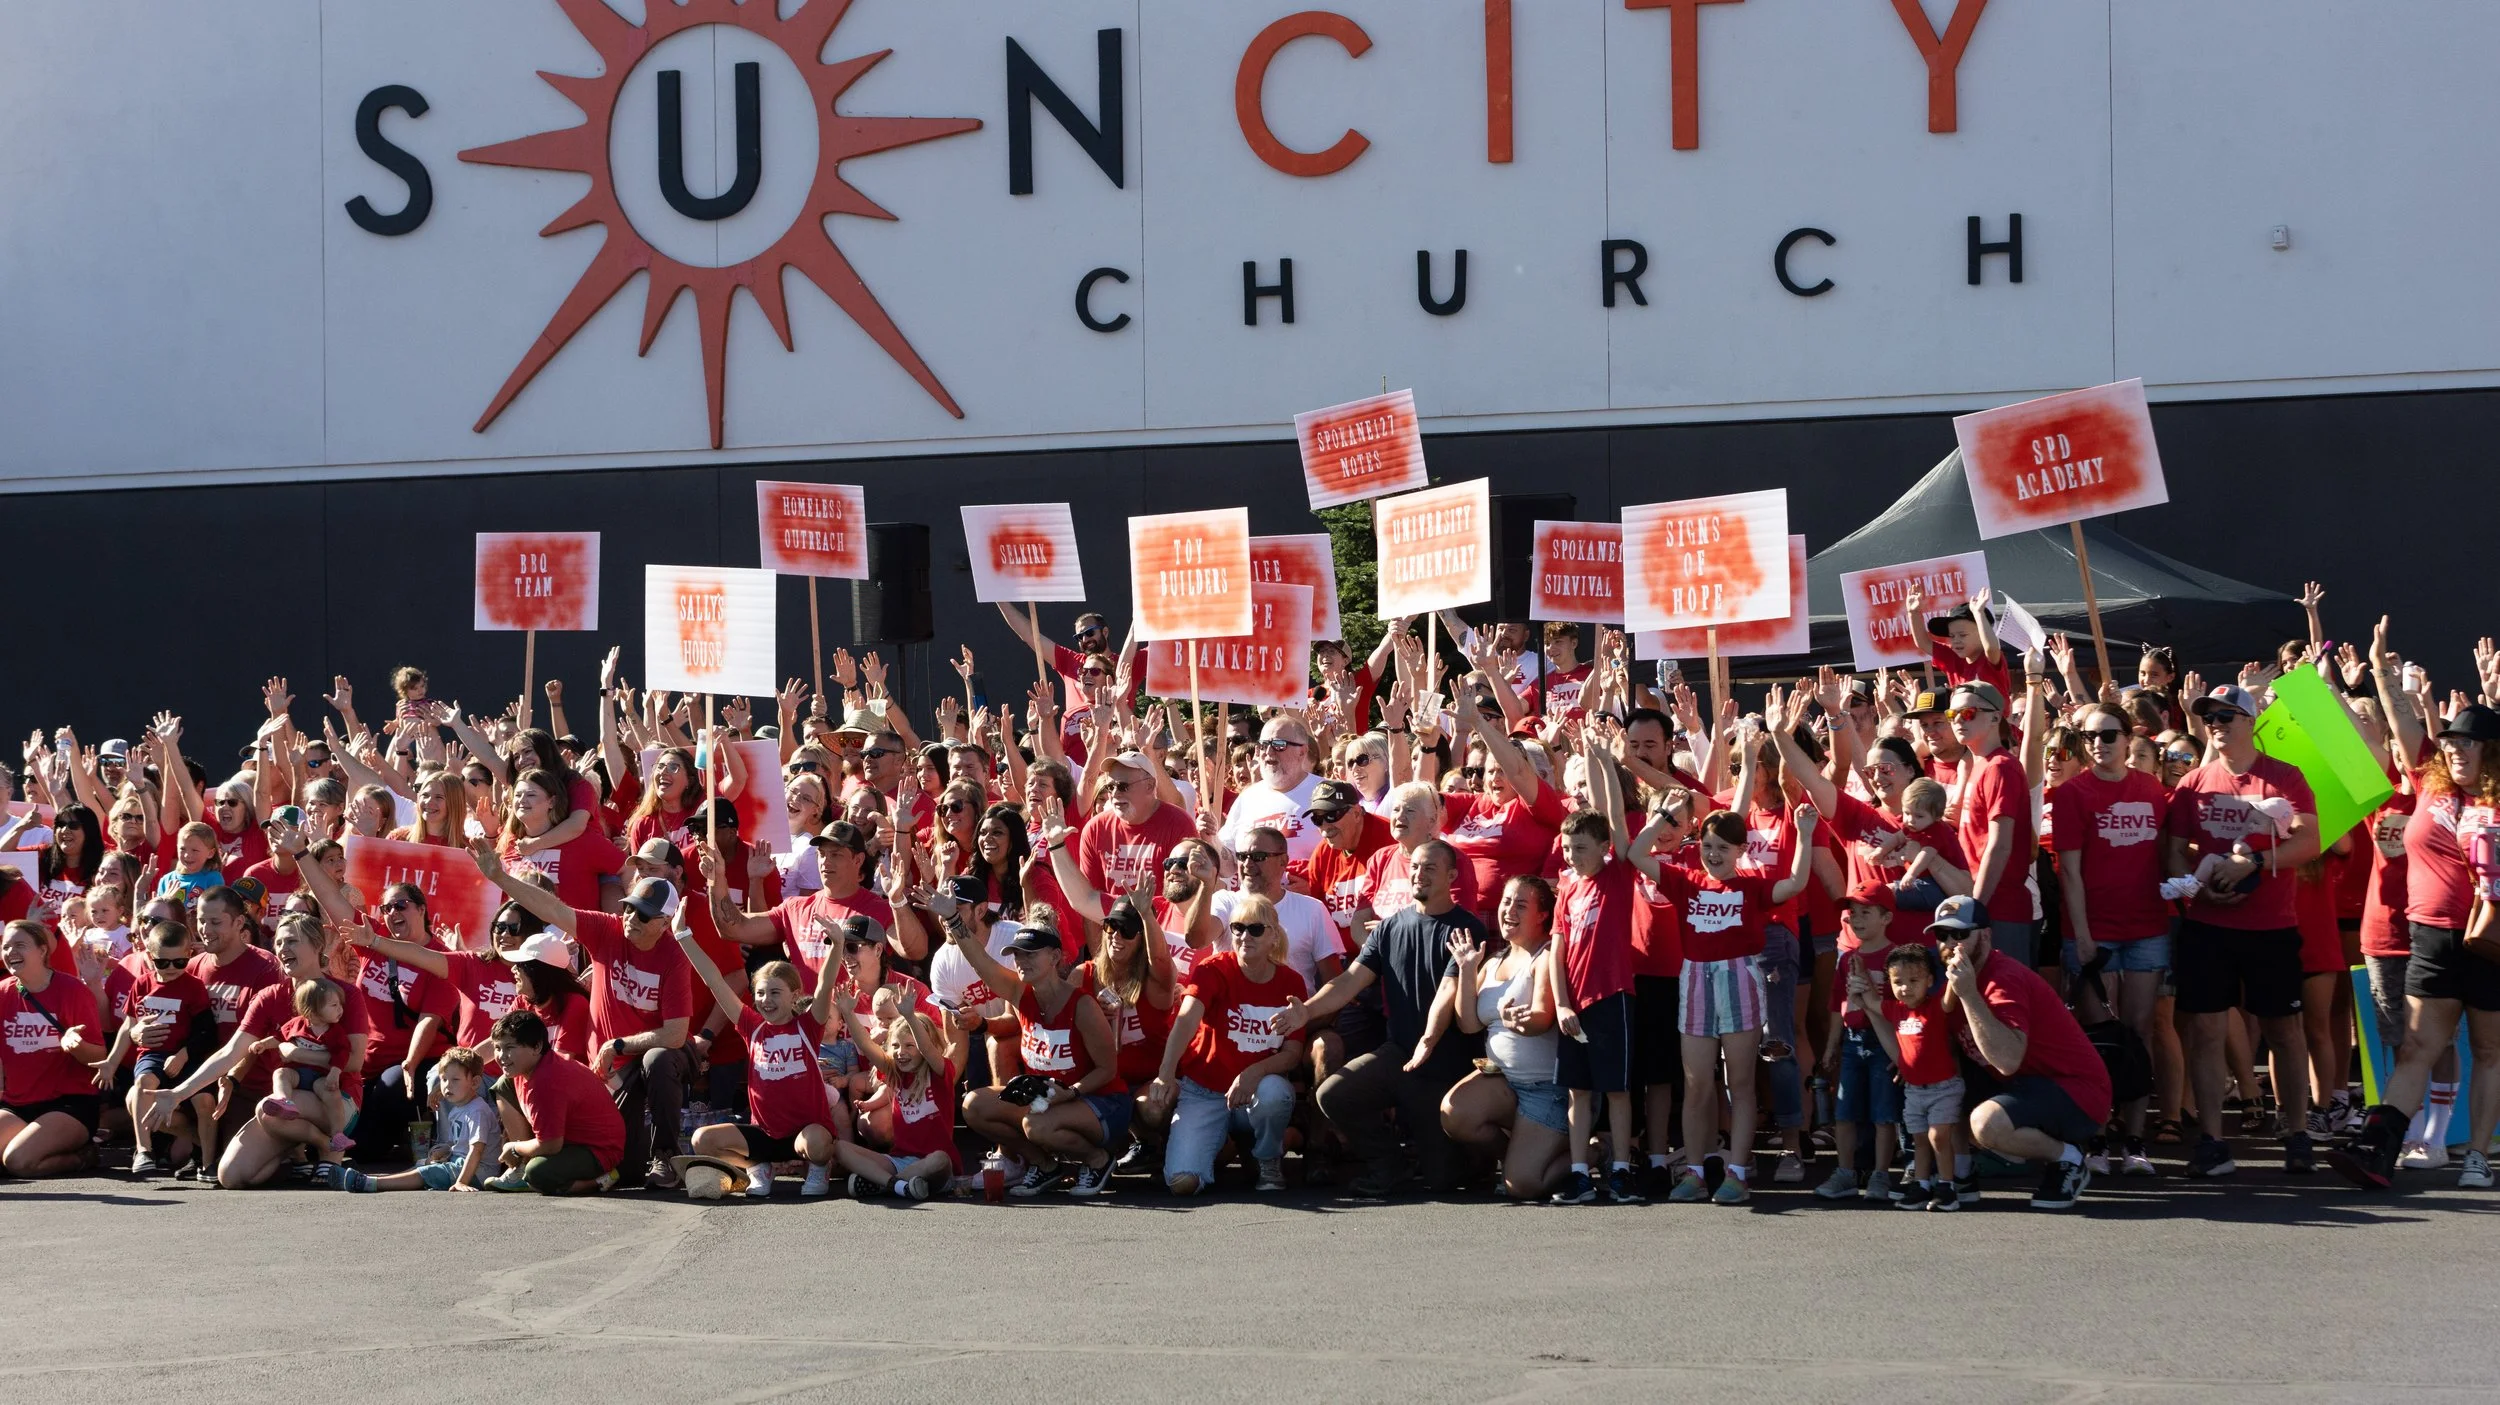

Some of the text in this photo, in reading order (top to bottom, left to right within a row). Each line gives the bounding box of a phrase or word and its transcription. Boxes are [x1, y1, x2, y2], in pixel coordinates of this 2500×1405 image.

[1235, 0, 1988, 178] CITY
[1075, 213, 2023, 332] CHURCH
[1317, 415, 1394, 452] SPOKANE127
[2032, 433, 2071, 465] SPD
[1340, 450, 1382, 478] NOTES
[2015, 457, 2105, 501] ACADEMY
[783, 496, 842, 520] HOMELESS
[1392, 505, 1471, 545] UNIVERSITY
[1666, 516, 1720, 547] SIGNS
[785, 529, 844, 552] OUTREACH
[1000, 543, 1048, 565] SELKIRK
[1174, 538, 1203, 565] TOY
[520, 552, 548, 574] BBQ
[1253, 560, 1282, 582] IFE
[1395, 544, 1475, 583] ELEMENTARY
[1683, 550, 1705, 577] OF
[515, 576, 552, 597] TEAM
[1160, 567, 1228, 597] BUILDERS
[1545, 574, 1612, 598] SURVIVAL
[679, 593, 724, 622] SALLY'S
[1672, 583, 1723, 615] HOPE
[683, 639, 724, 668] HOUSE
[1174, 641, 1283, 672] BANKETS
[2097, 815, 2157, 829] SERVE
[2199, 808, 2249, 823] SERV
[384, 866, 439, 896] LIVE
[1327, 894, 1355, 912] SER
[1374, 891, 1413, 906] SERV
[1688, 902, 1742, 917] SERVE
[612, 967, 660, 1001] SERVE
[5, 1023, 58, 1038] SERVE
[1228, 1014, 1277, 1036] SERV
[1021, 1033, 1072, 1058] SERVE
